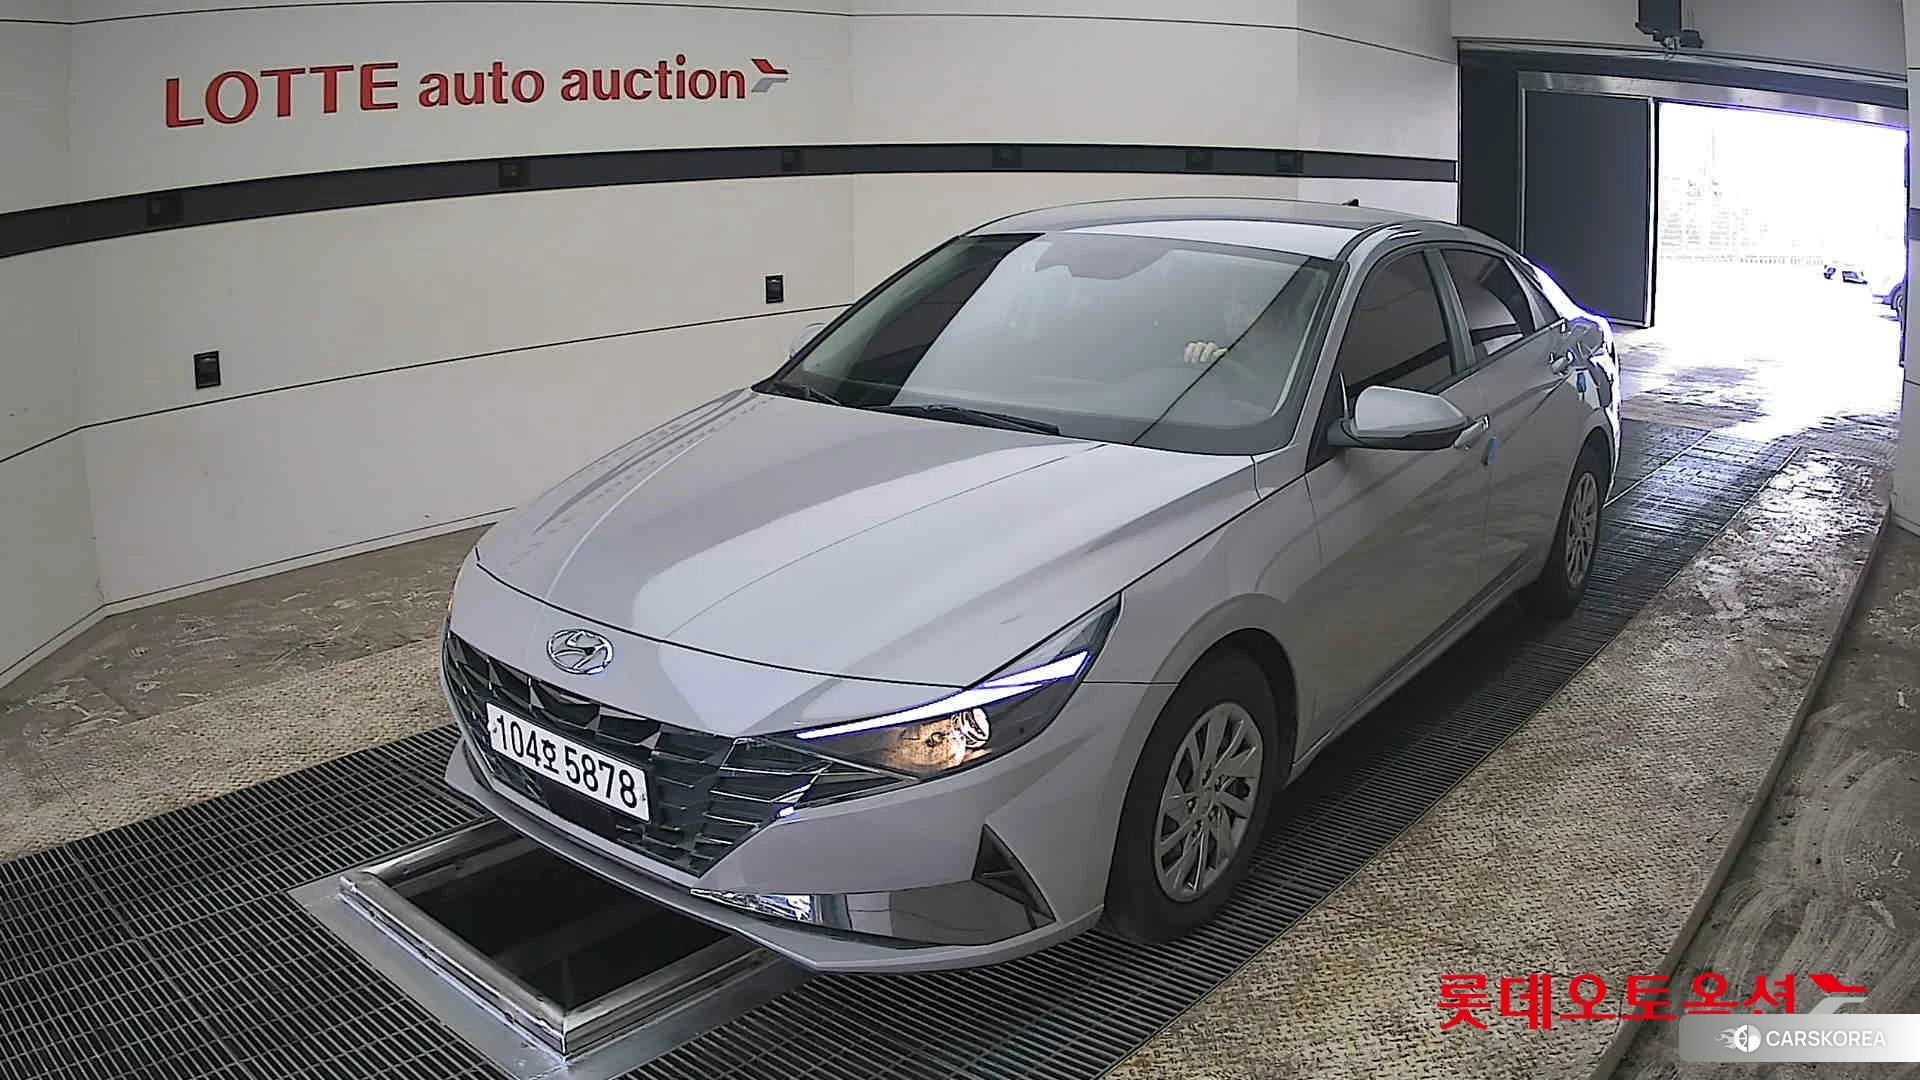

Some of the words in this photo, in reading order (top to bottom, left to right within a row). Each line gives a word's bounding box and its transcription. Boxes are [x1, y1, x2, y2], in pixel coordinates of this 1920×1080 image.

[165, 62, 399, 128] LOTTE
[418, 61, 545, 108] auto
[560, 54, 746, 101] auction
